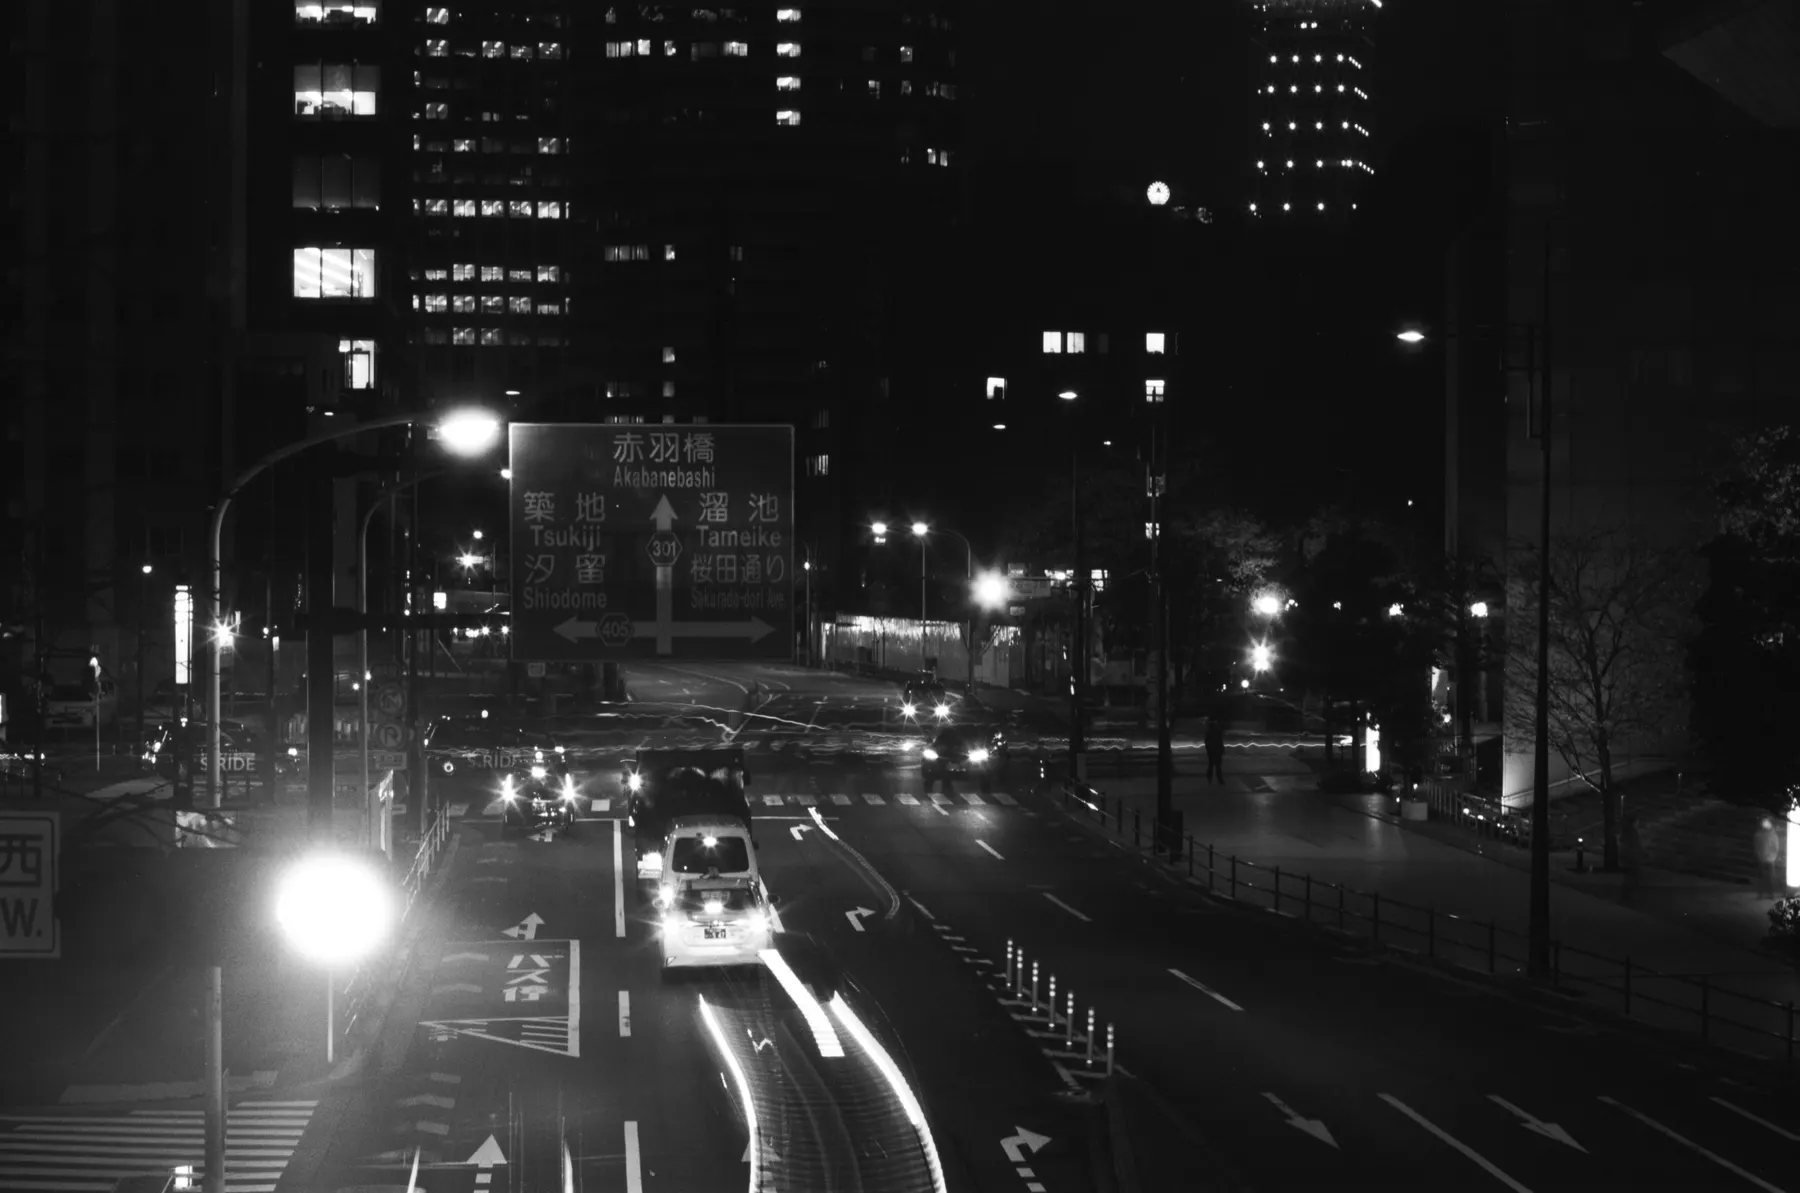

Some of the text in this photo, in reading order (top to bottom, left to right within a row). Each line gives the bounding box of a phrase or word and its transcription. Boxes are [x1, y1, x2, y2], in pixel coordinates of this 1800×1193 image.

[613, 432, 715, 463] 赤羽橋
[613, 466, 716, 488] Akabanebashi
[529, 525, 601, 551] Tsukiji
[696, 525, 782, 547] Tameike
[652, 541, 677, 557] 301
[690, 554, 785, 584] 桜田通り
[523, 587, 608, 609] Shiodome
[602, 620, 628, 637] 405
[0, 833, 43, 887] 西
